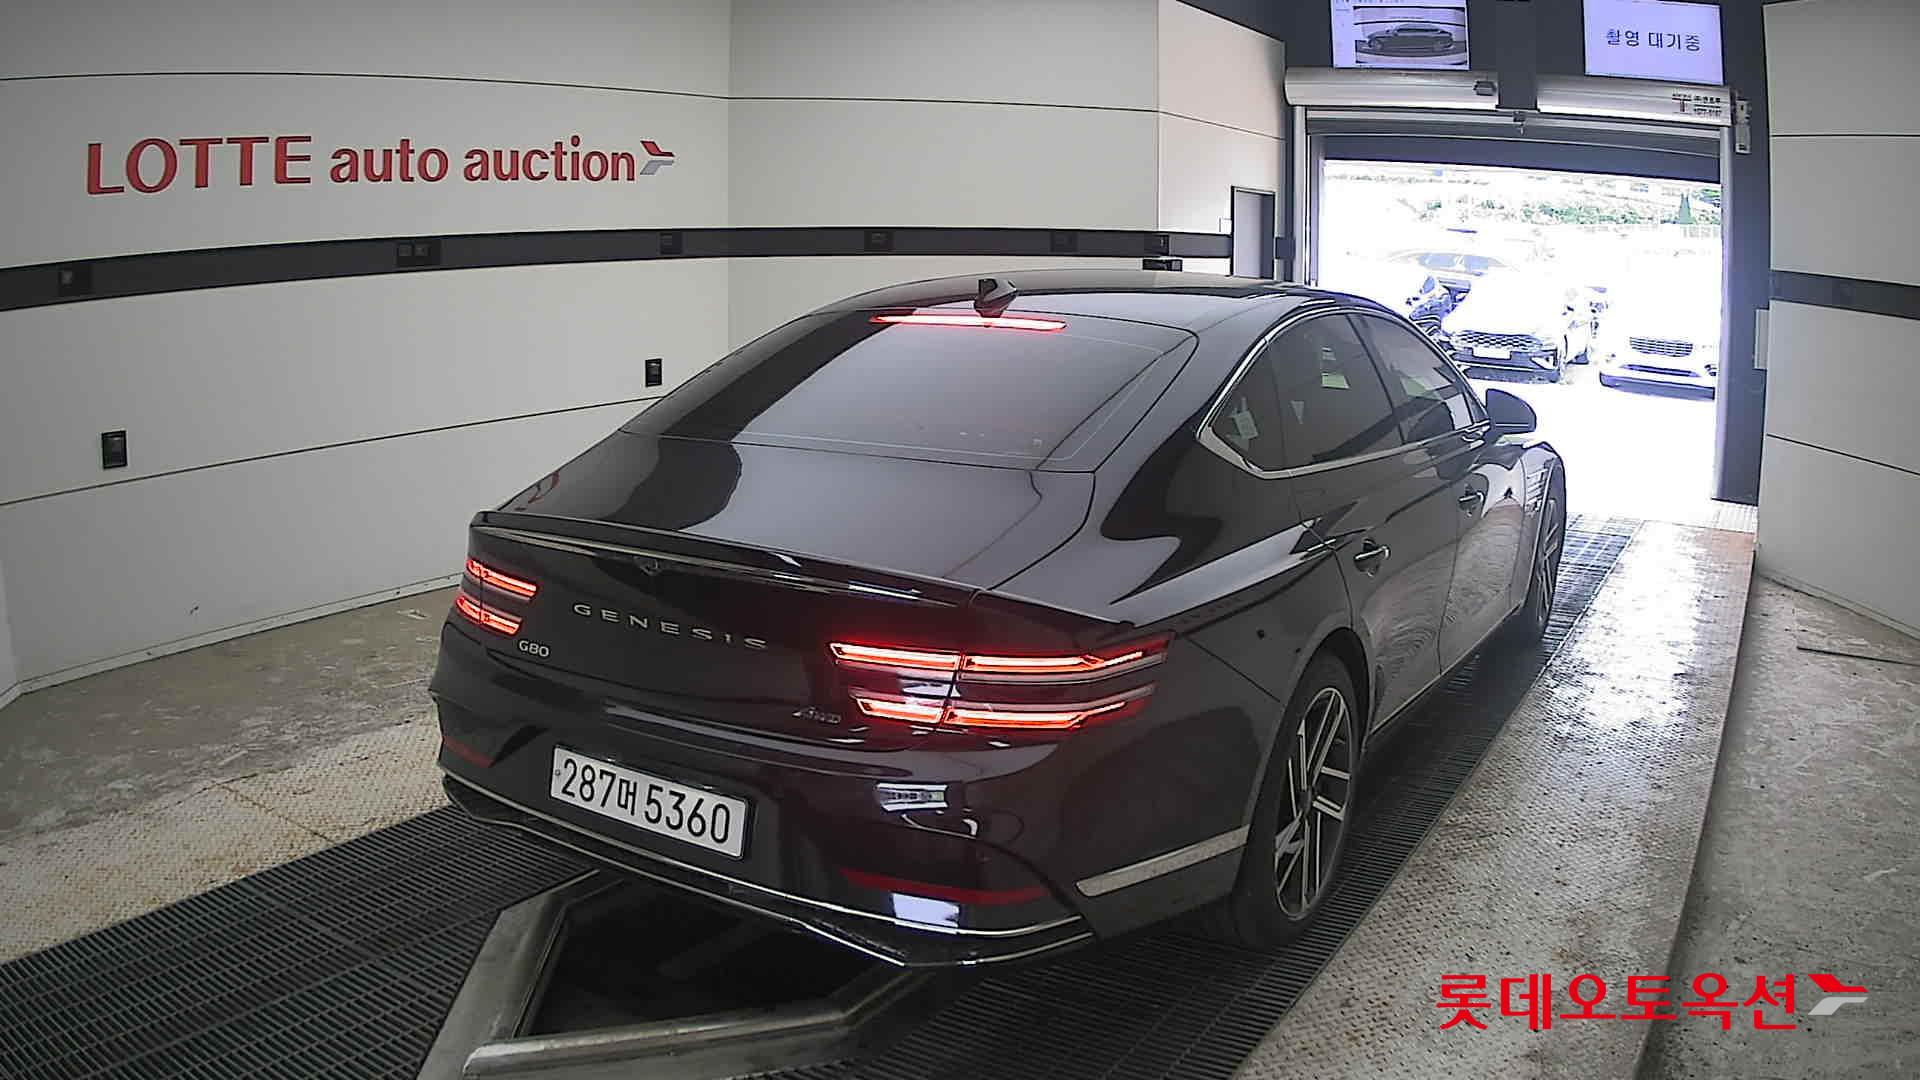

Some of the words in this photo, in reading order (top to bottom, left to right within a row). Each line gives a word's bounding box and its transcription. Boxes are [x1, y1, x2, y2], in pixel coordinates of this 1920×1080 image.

[1607, 28, 1640, 47] 촬영
[1648, 31, 1701, 52] 대기중
[87, 135, 312, 195] LOTTE
[329, 138, 449, 183] auto
[463, 135, 636, 182] auction
[518, 638, 550, 658] G80
[572, 603, 769, 650] GENESIS
[643, 785, 732, 844] 5360
